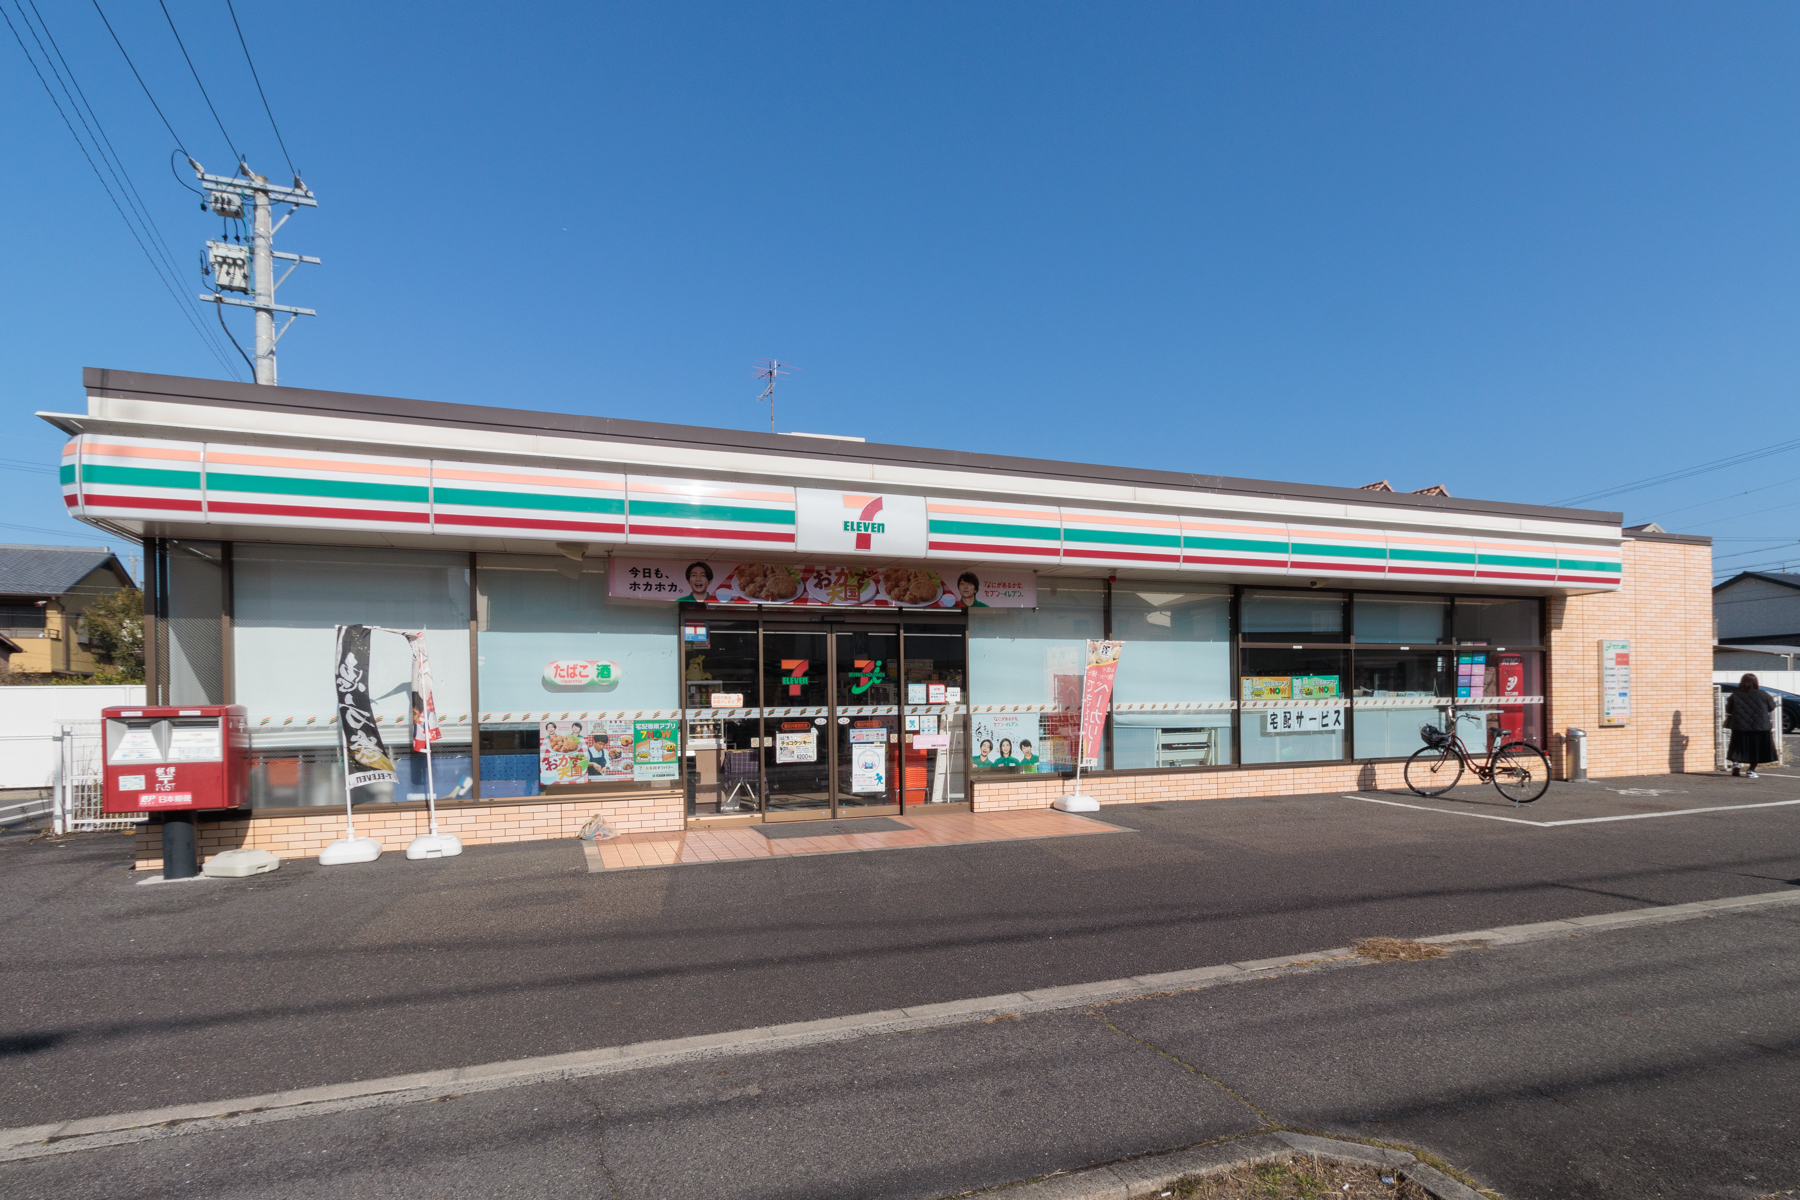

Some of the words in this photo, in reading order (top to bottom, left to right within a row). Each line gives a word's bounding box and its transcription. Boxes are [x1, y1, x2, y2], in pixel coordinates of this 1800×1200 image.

[629, 567, 670, 579] 今日も、
[629, 582, 684, 593] ホカホカ。
[824, 584, 861, 605] 天国
[553, 664, 589, 679] たばこ
[596, 664, 612, 679] 酒
[1266, 687, 1287, 695] 7NOW
[1269, 709, 1341, 730] 宅配サービス
[640, 730, 672, 739] 7NOW
[155, 766, 176, 776] 郵便
[556, 765, 583, 781] 天国
[155, 782, 176, 792] POST
[158, 794, 192, 803] 日本郵便
